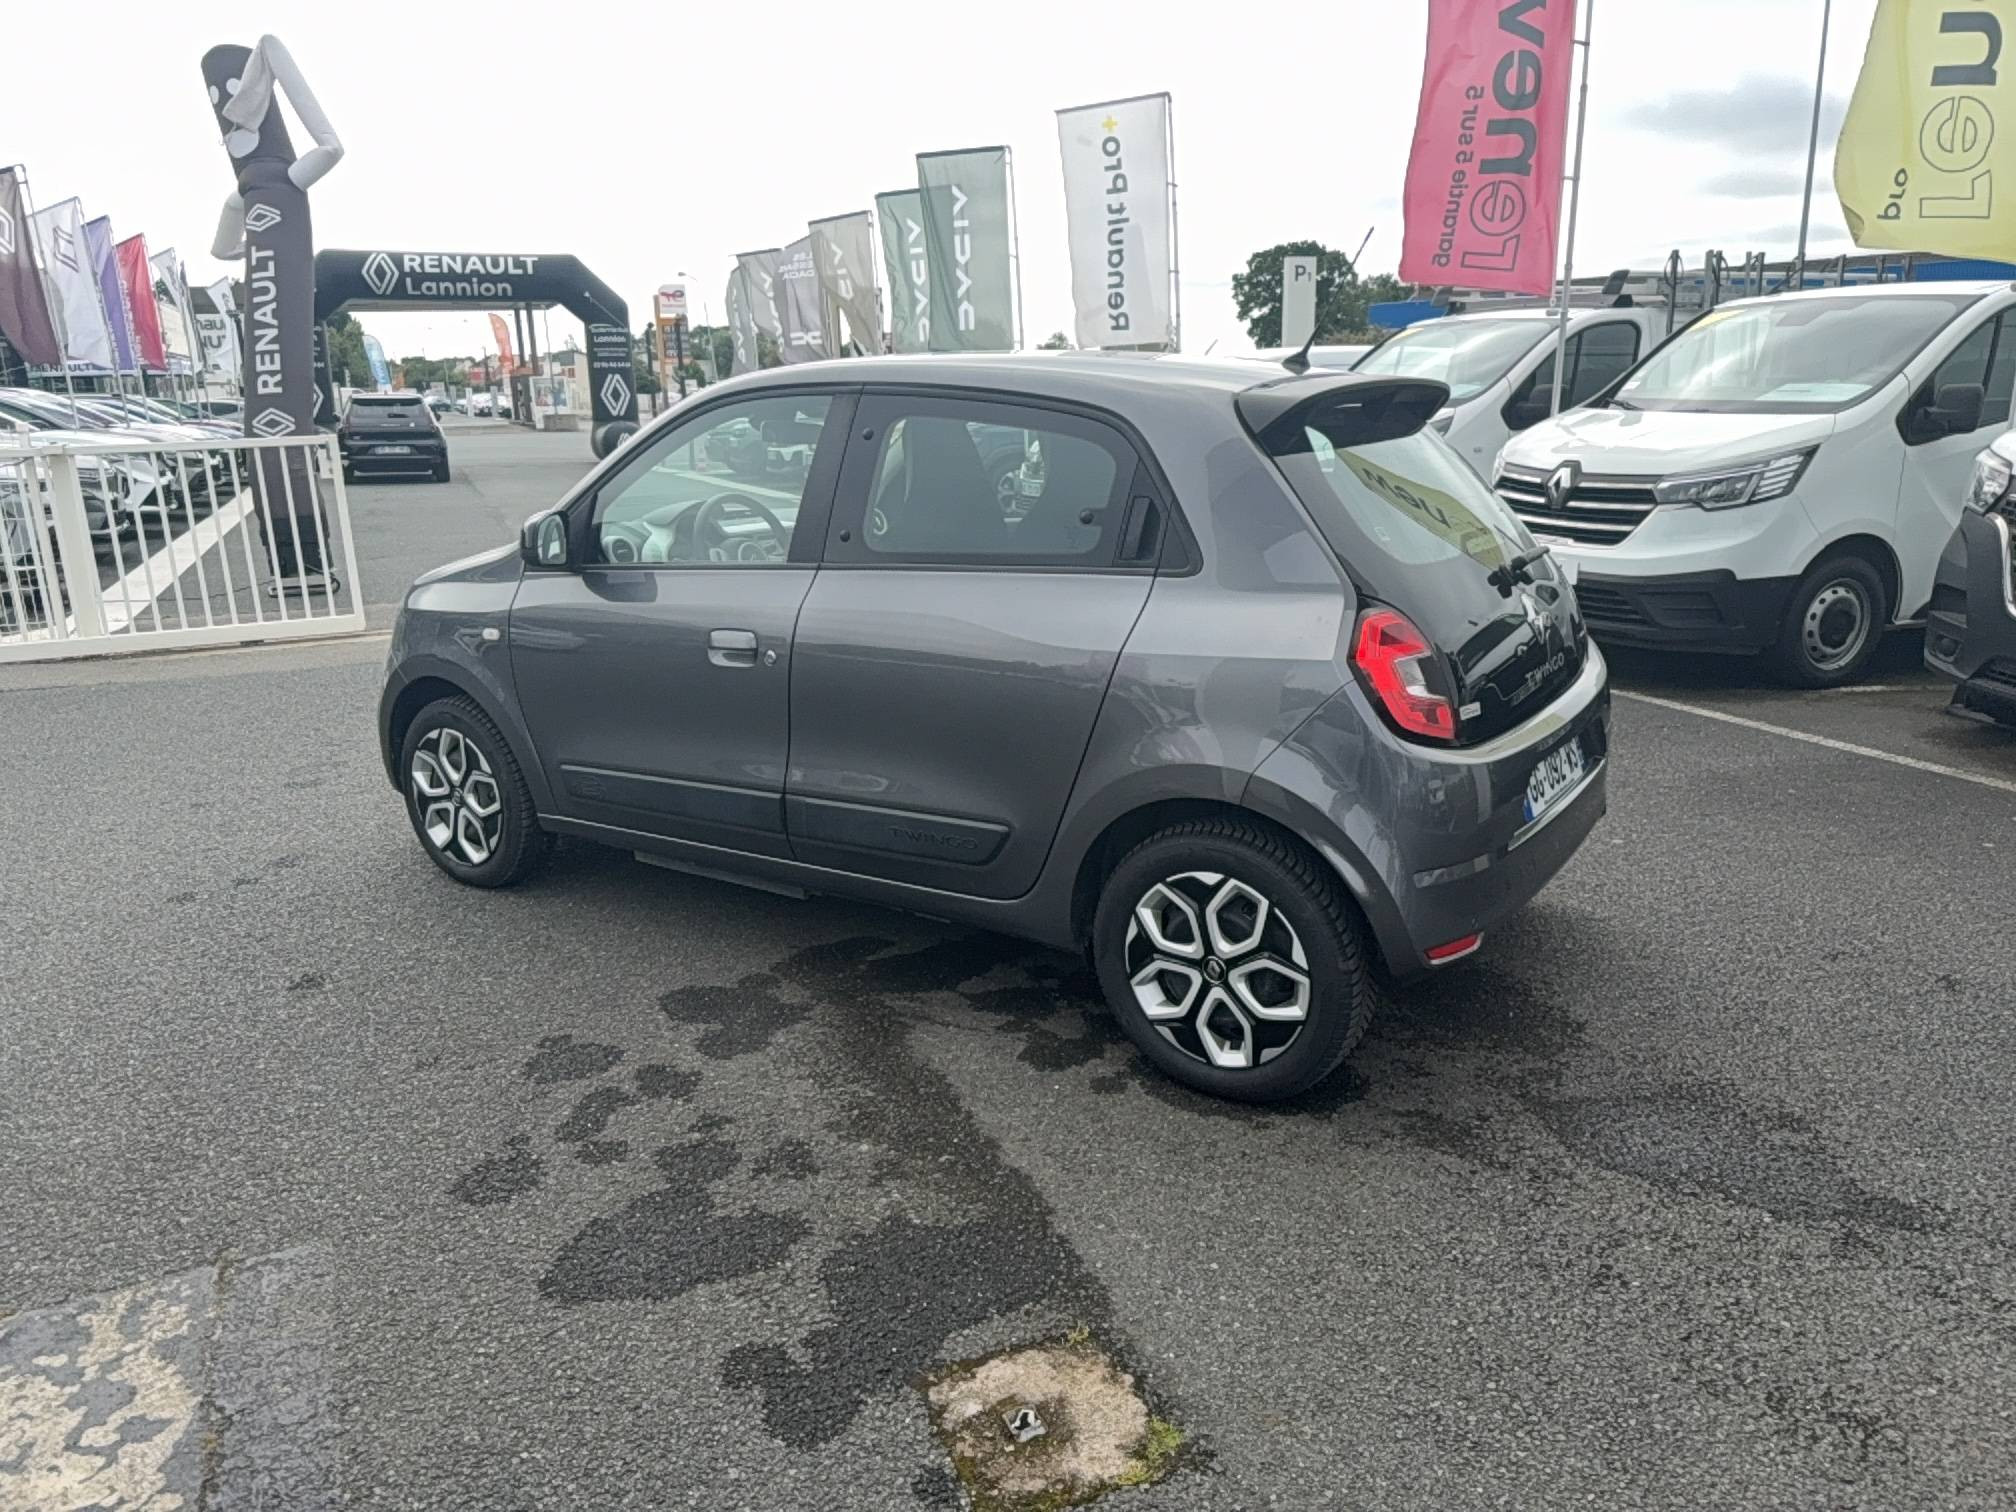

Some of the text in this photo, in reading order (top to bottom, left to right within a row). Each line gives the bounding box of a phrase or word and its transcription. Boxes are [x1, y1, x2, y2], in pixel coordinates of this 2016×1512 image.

[403, 254, 539, 275] RENAULT
[405, 277, 513, 298] Lannion
[251, 245, 283, 395] RENAULT
[1524, 653, 1565, 686] TWINGO
[888, 825, 978, 849] TWINGO
